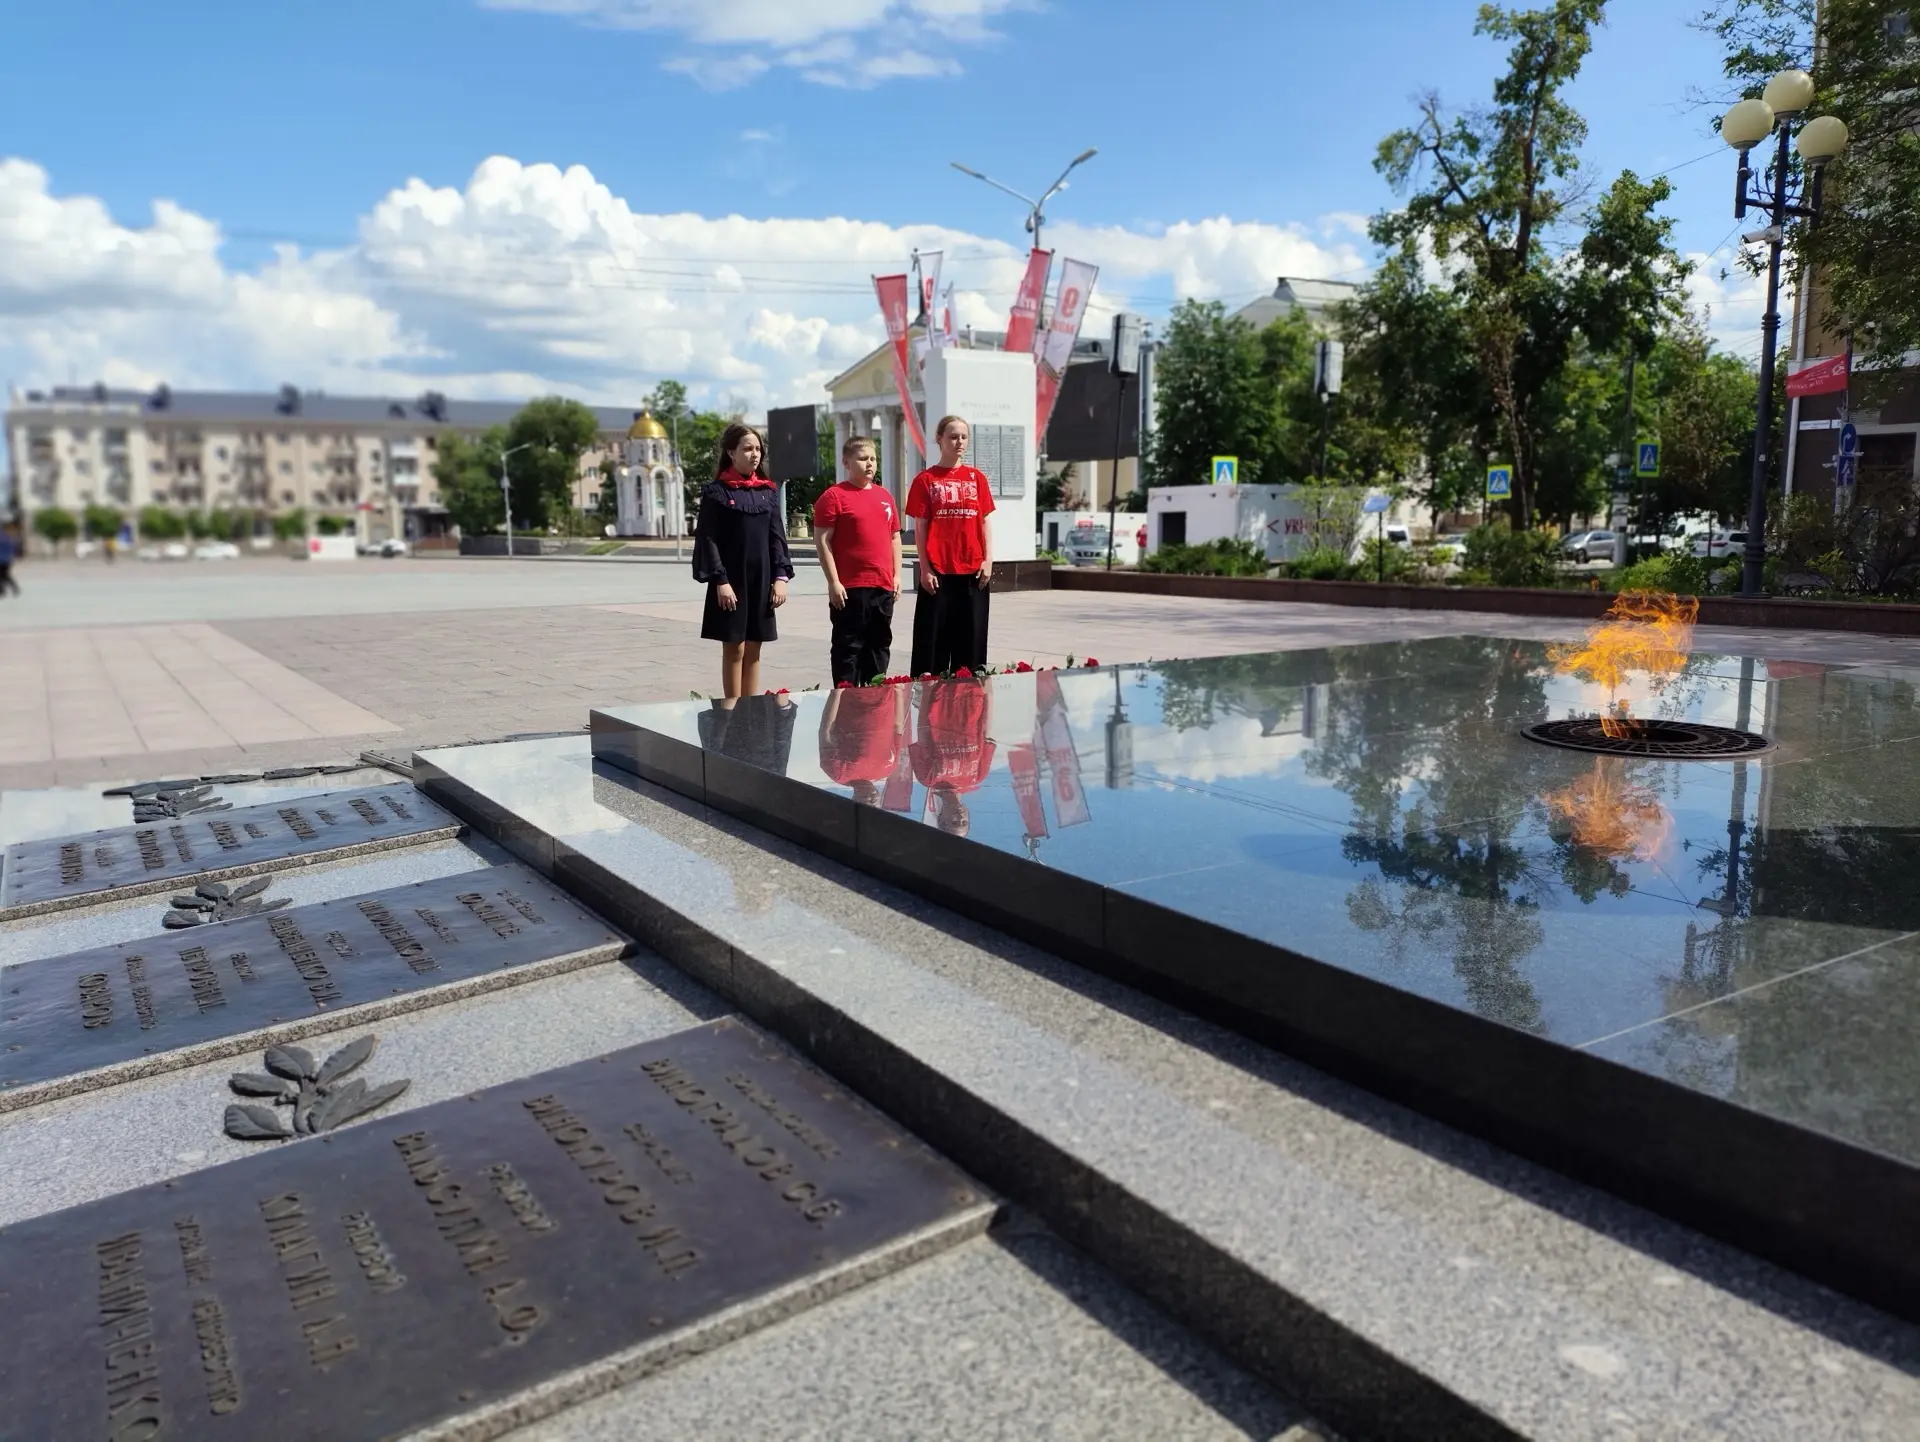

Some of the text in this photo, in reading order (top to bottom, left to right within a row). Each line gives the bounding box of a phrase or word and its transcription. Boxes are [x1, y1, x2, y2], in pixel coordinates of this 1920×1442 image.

[178, 946, 218, 988] ПЕТРОВ
[523, 1095, 657, 1223] ВИНОКУРОВ
[642, 1060, 791, 1180] ВИНОГРАДОВ
[258, 1192, 338, 1308] КУЛАГИН
[341, 1211, 404, 1293] РЯДОВОЙ
[479, 1162, 558, 1231] РЯДОВОЙ
[96, 1231, 165, 1442] ИВАНИЧЕНКО
